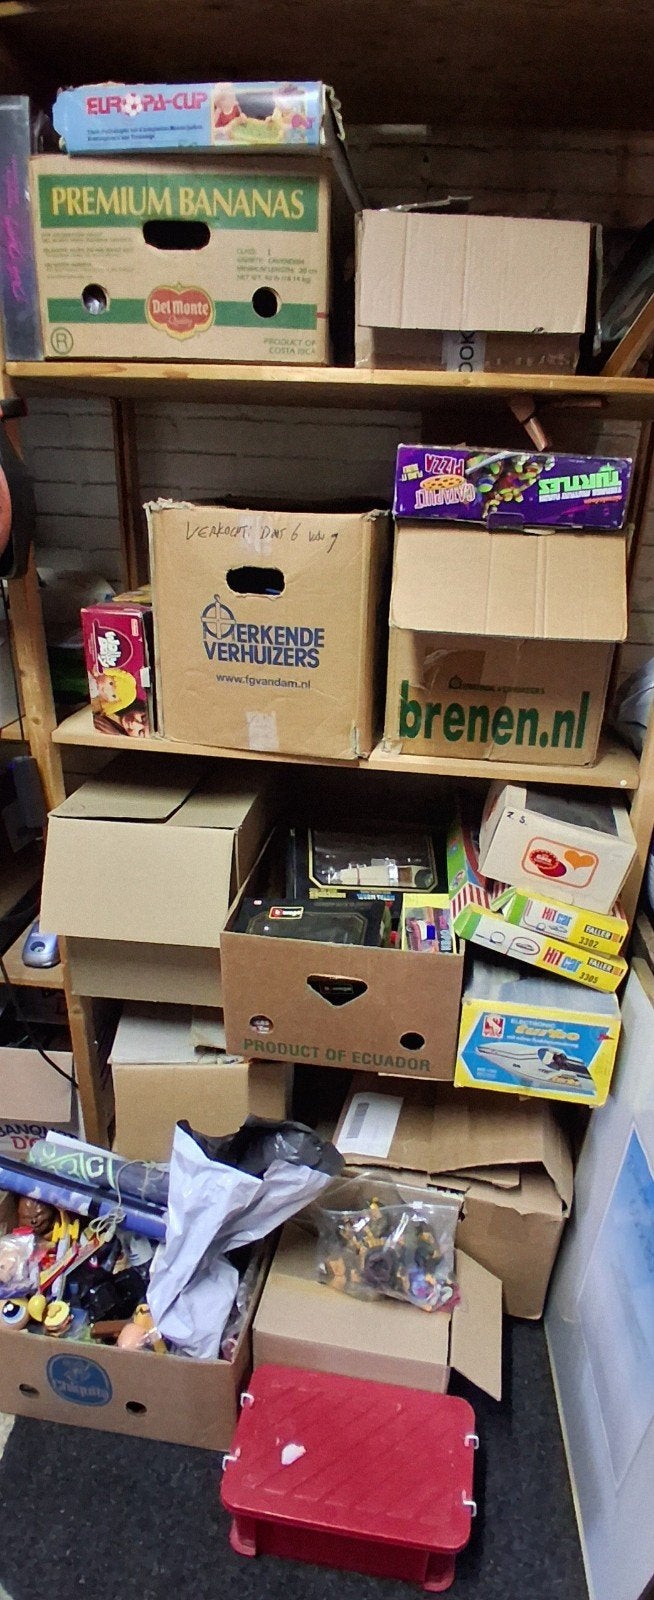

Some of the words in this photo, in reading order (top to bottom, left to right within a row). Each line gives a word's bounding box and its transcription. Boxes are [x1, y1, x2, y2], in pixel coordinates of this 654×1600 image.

[51, 186, 173, 217] PREMIUM
[179, 187, 305, 219] BANANAS
[152, 300, 171, 315] Del
[172, 300, 211, 316] Monte
[56, 333, 67, 347] R
[425, 454, 464, 476] PIZZA
[538, 470, 623, 495] TURTLES
[415, 484, 476, 509] CATAPULT
[237, 623, 325, 648] ERKENDE
[203, 641, 320, 669] VERHUIZERS
[216, 674, 311, 689] www.fgvandam.nl
[399, 679, 590, 749] brenen.nl
[579, 936, 599, 948] 3302
[585, 925, 612, 940] FALLER
[588, 957, 613, 973] FALLER
[579, 972, 599, 984] 3305
[243, 1038, 320, 1058] PRODUCT
[325, 1048, 348, 1062] OF
[352, 1052, 431, 1072] ECUADOR
